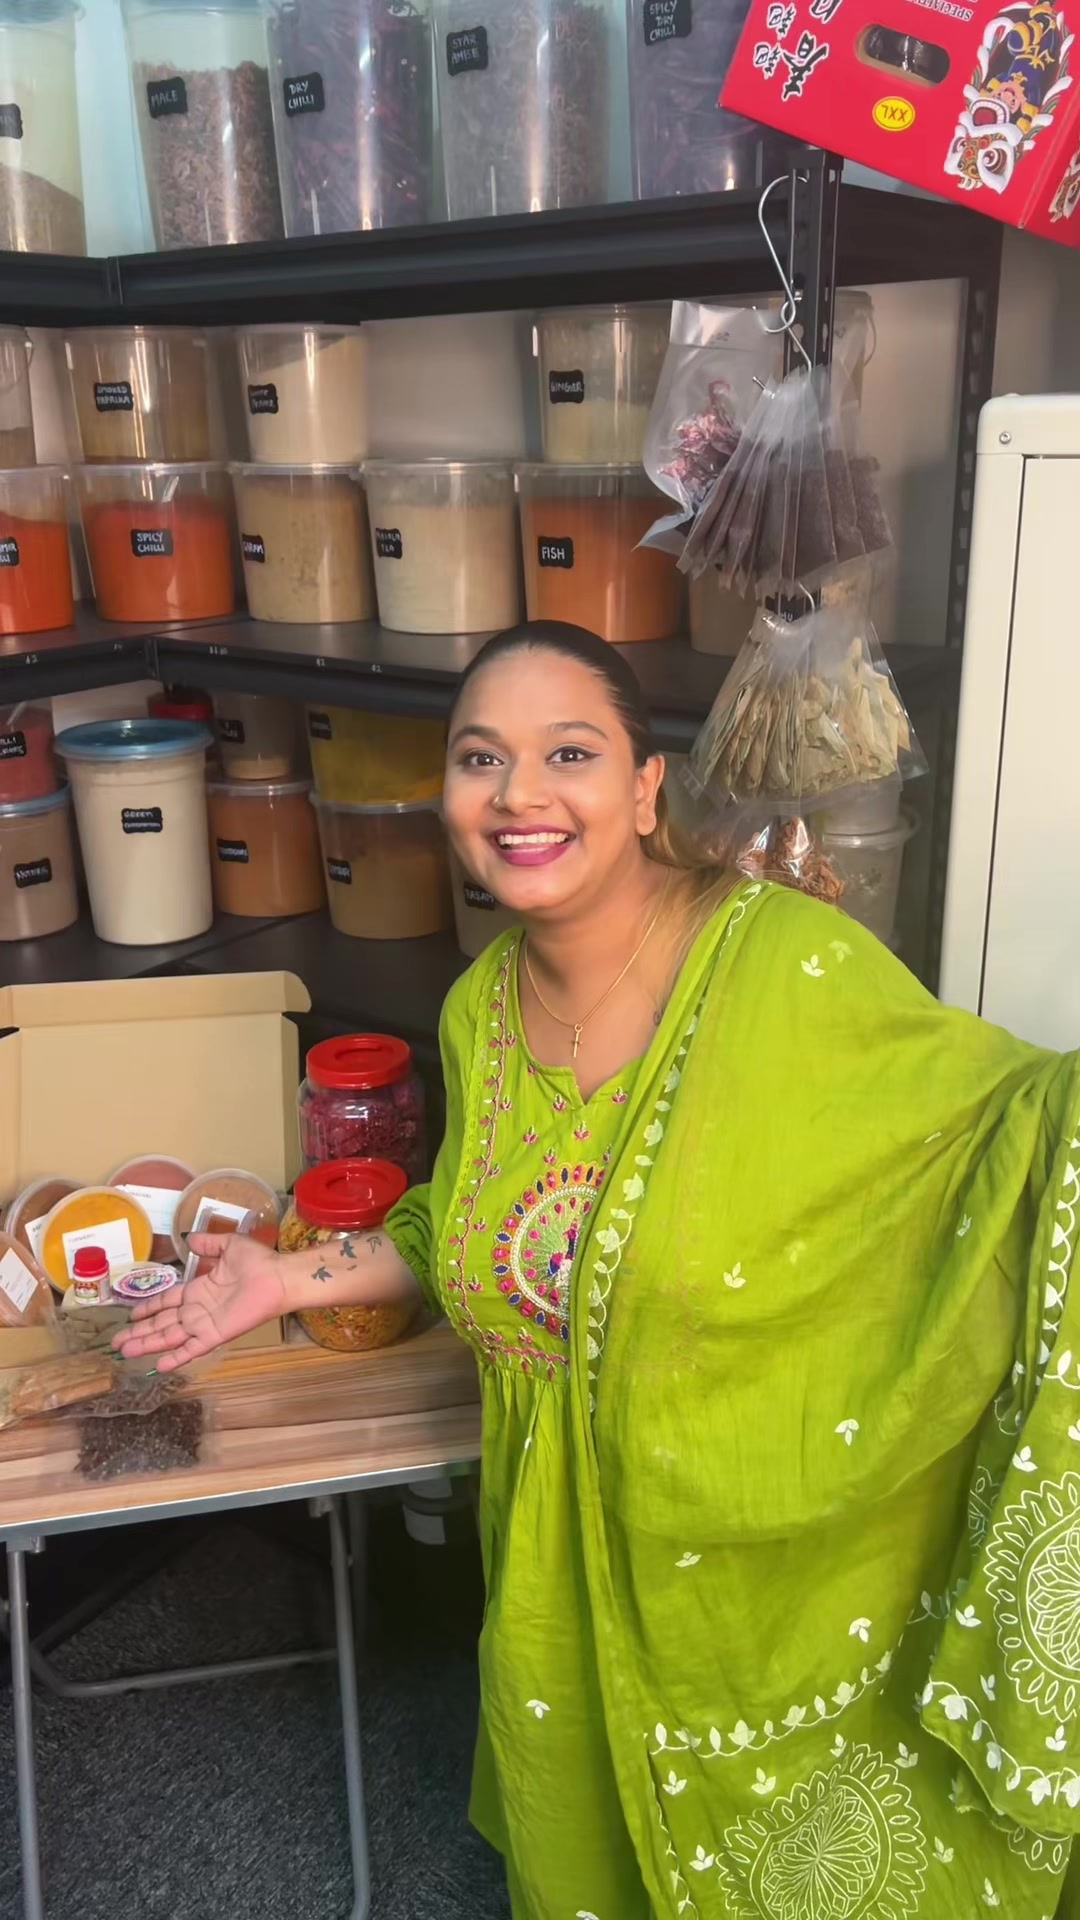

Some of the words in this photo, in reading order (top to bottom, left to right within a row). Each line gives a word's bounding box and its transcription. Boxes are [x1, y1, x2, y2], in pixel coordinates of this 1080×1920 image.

[649, 0, 677, 15] SPICY
[656, 15, 673, 26] DRY
[452, 35, 477, 50] STAR
[289, 81, 309, 95] DRY
[151, 90, 177, 107] MACE
[288, 95, 315, 109] CHILLI
[881, 104, 909, 123] XXL
[550, 381, 582, 393] GINGER
[96, 396, 130, 405] PAPRIKA
[137, 532, 164, 542] SPICY
[137, 544, 165, 553] CHILLI
[542, 546, 565, 560] FISH
